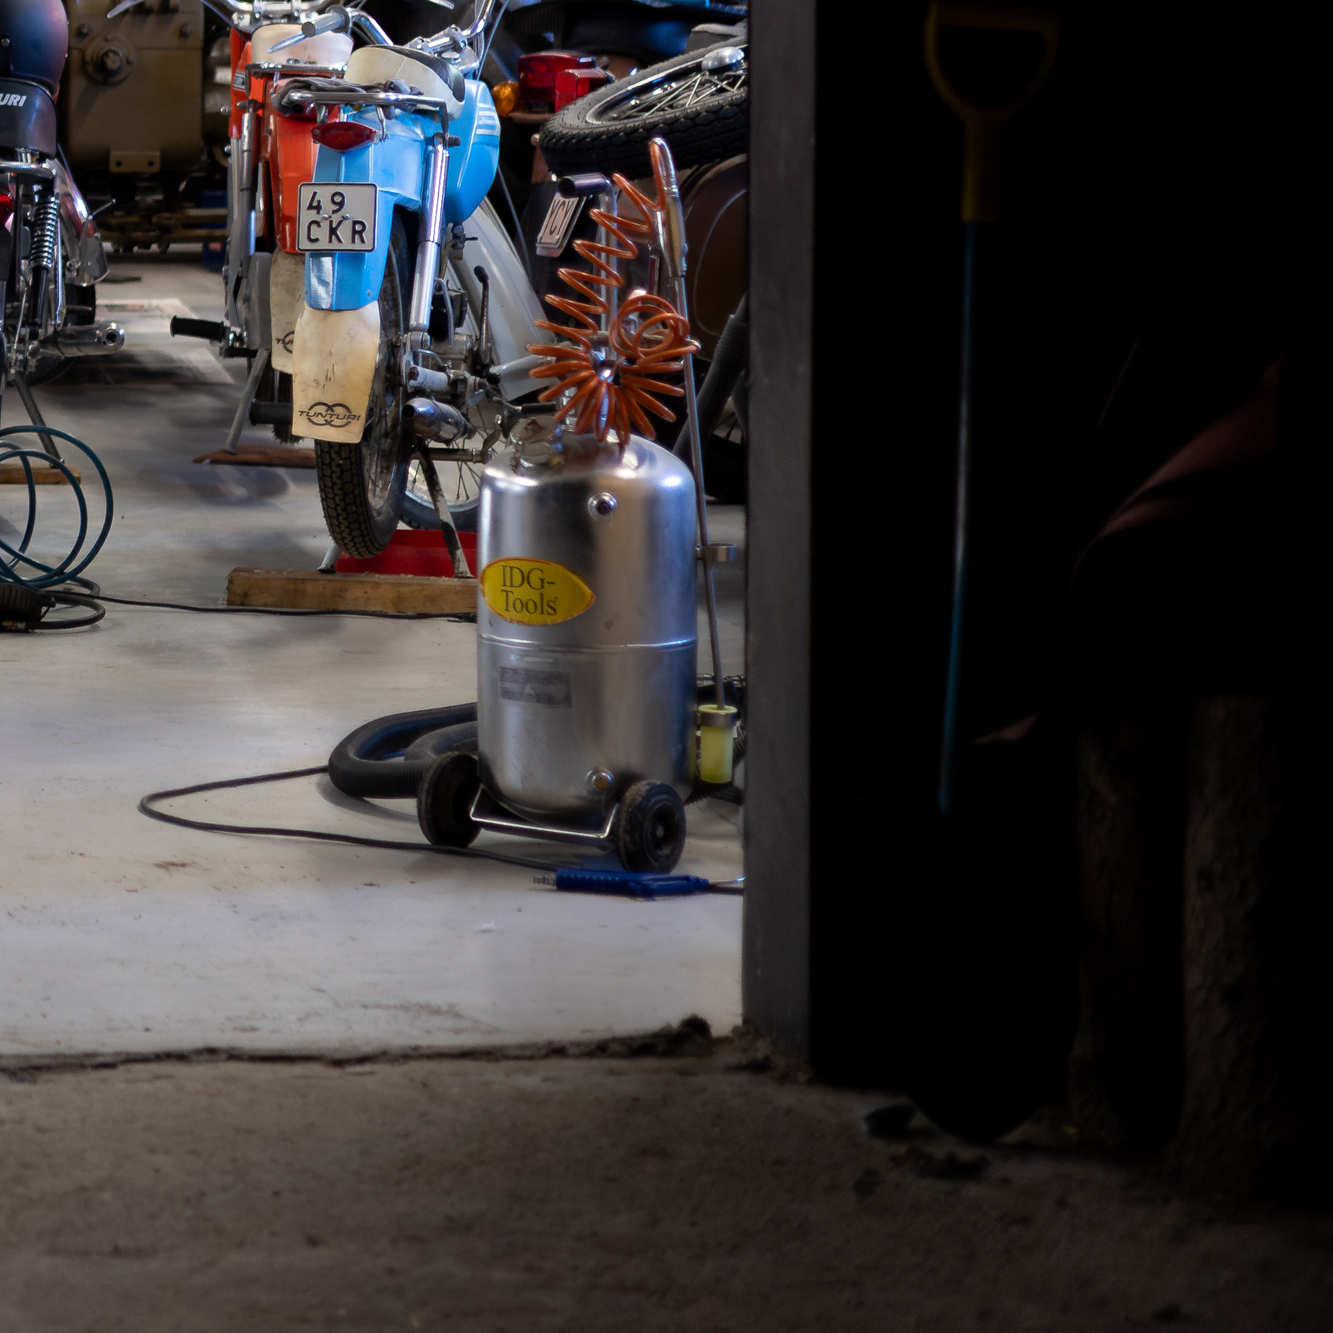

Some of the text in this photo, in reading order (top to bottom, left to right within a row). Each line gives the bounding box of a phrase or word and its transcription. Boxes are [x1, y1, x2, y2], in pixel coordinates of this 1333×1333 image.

[306, 191, 346, 214] 49
[307, 219, 367, 244] CKR
[298, 410, 361, 421] TUNTURI
[501, 565, 556, 590] IDG-
[501, 589, 558, 616] Tools
